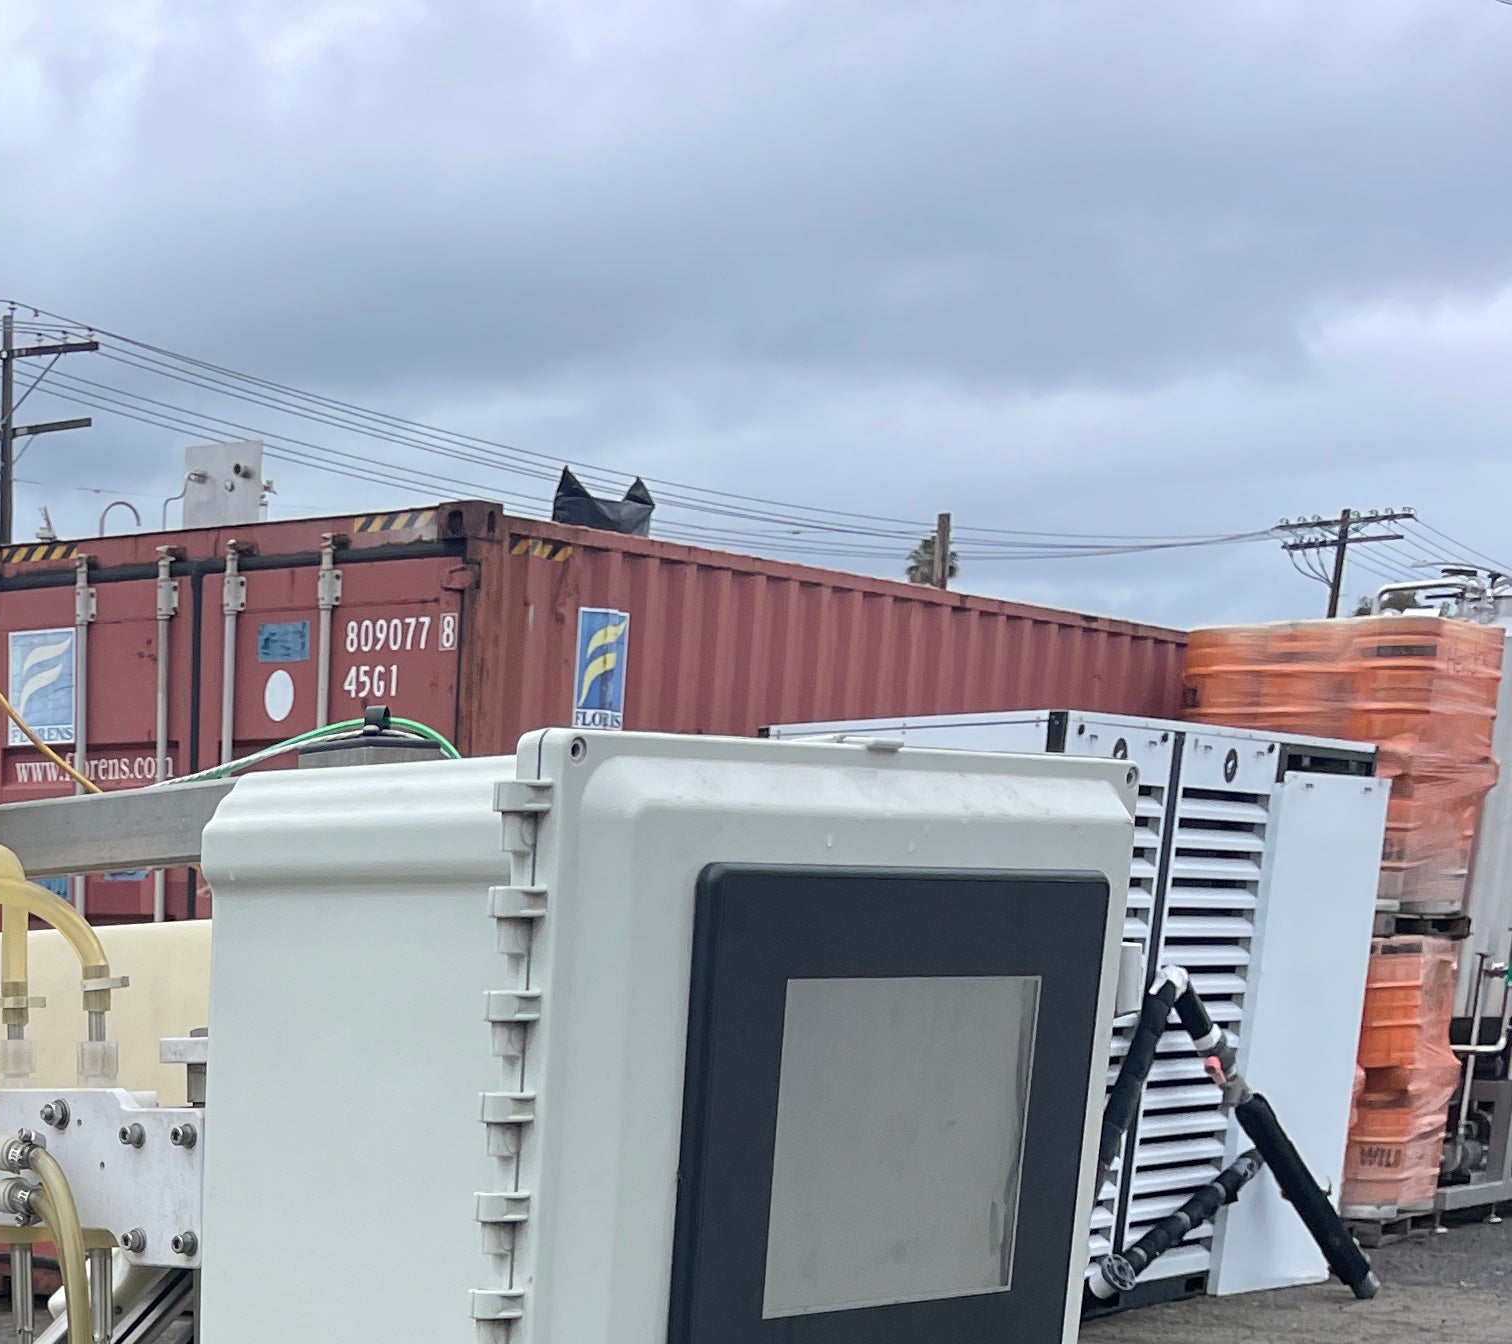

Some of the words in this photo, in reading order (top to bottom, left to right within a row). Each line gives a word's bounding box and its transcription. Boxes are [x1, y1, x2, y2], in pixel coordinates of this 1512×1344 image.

[345, 616, 431, 653] 809077
[441, 615, 455, 648] 8
[343, 664, 399, 698] 45G1
[10, 726, 74, 744] FLRENS
